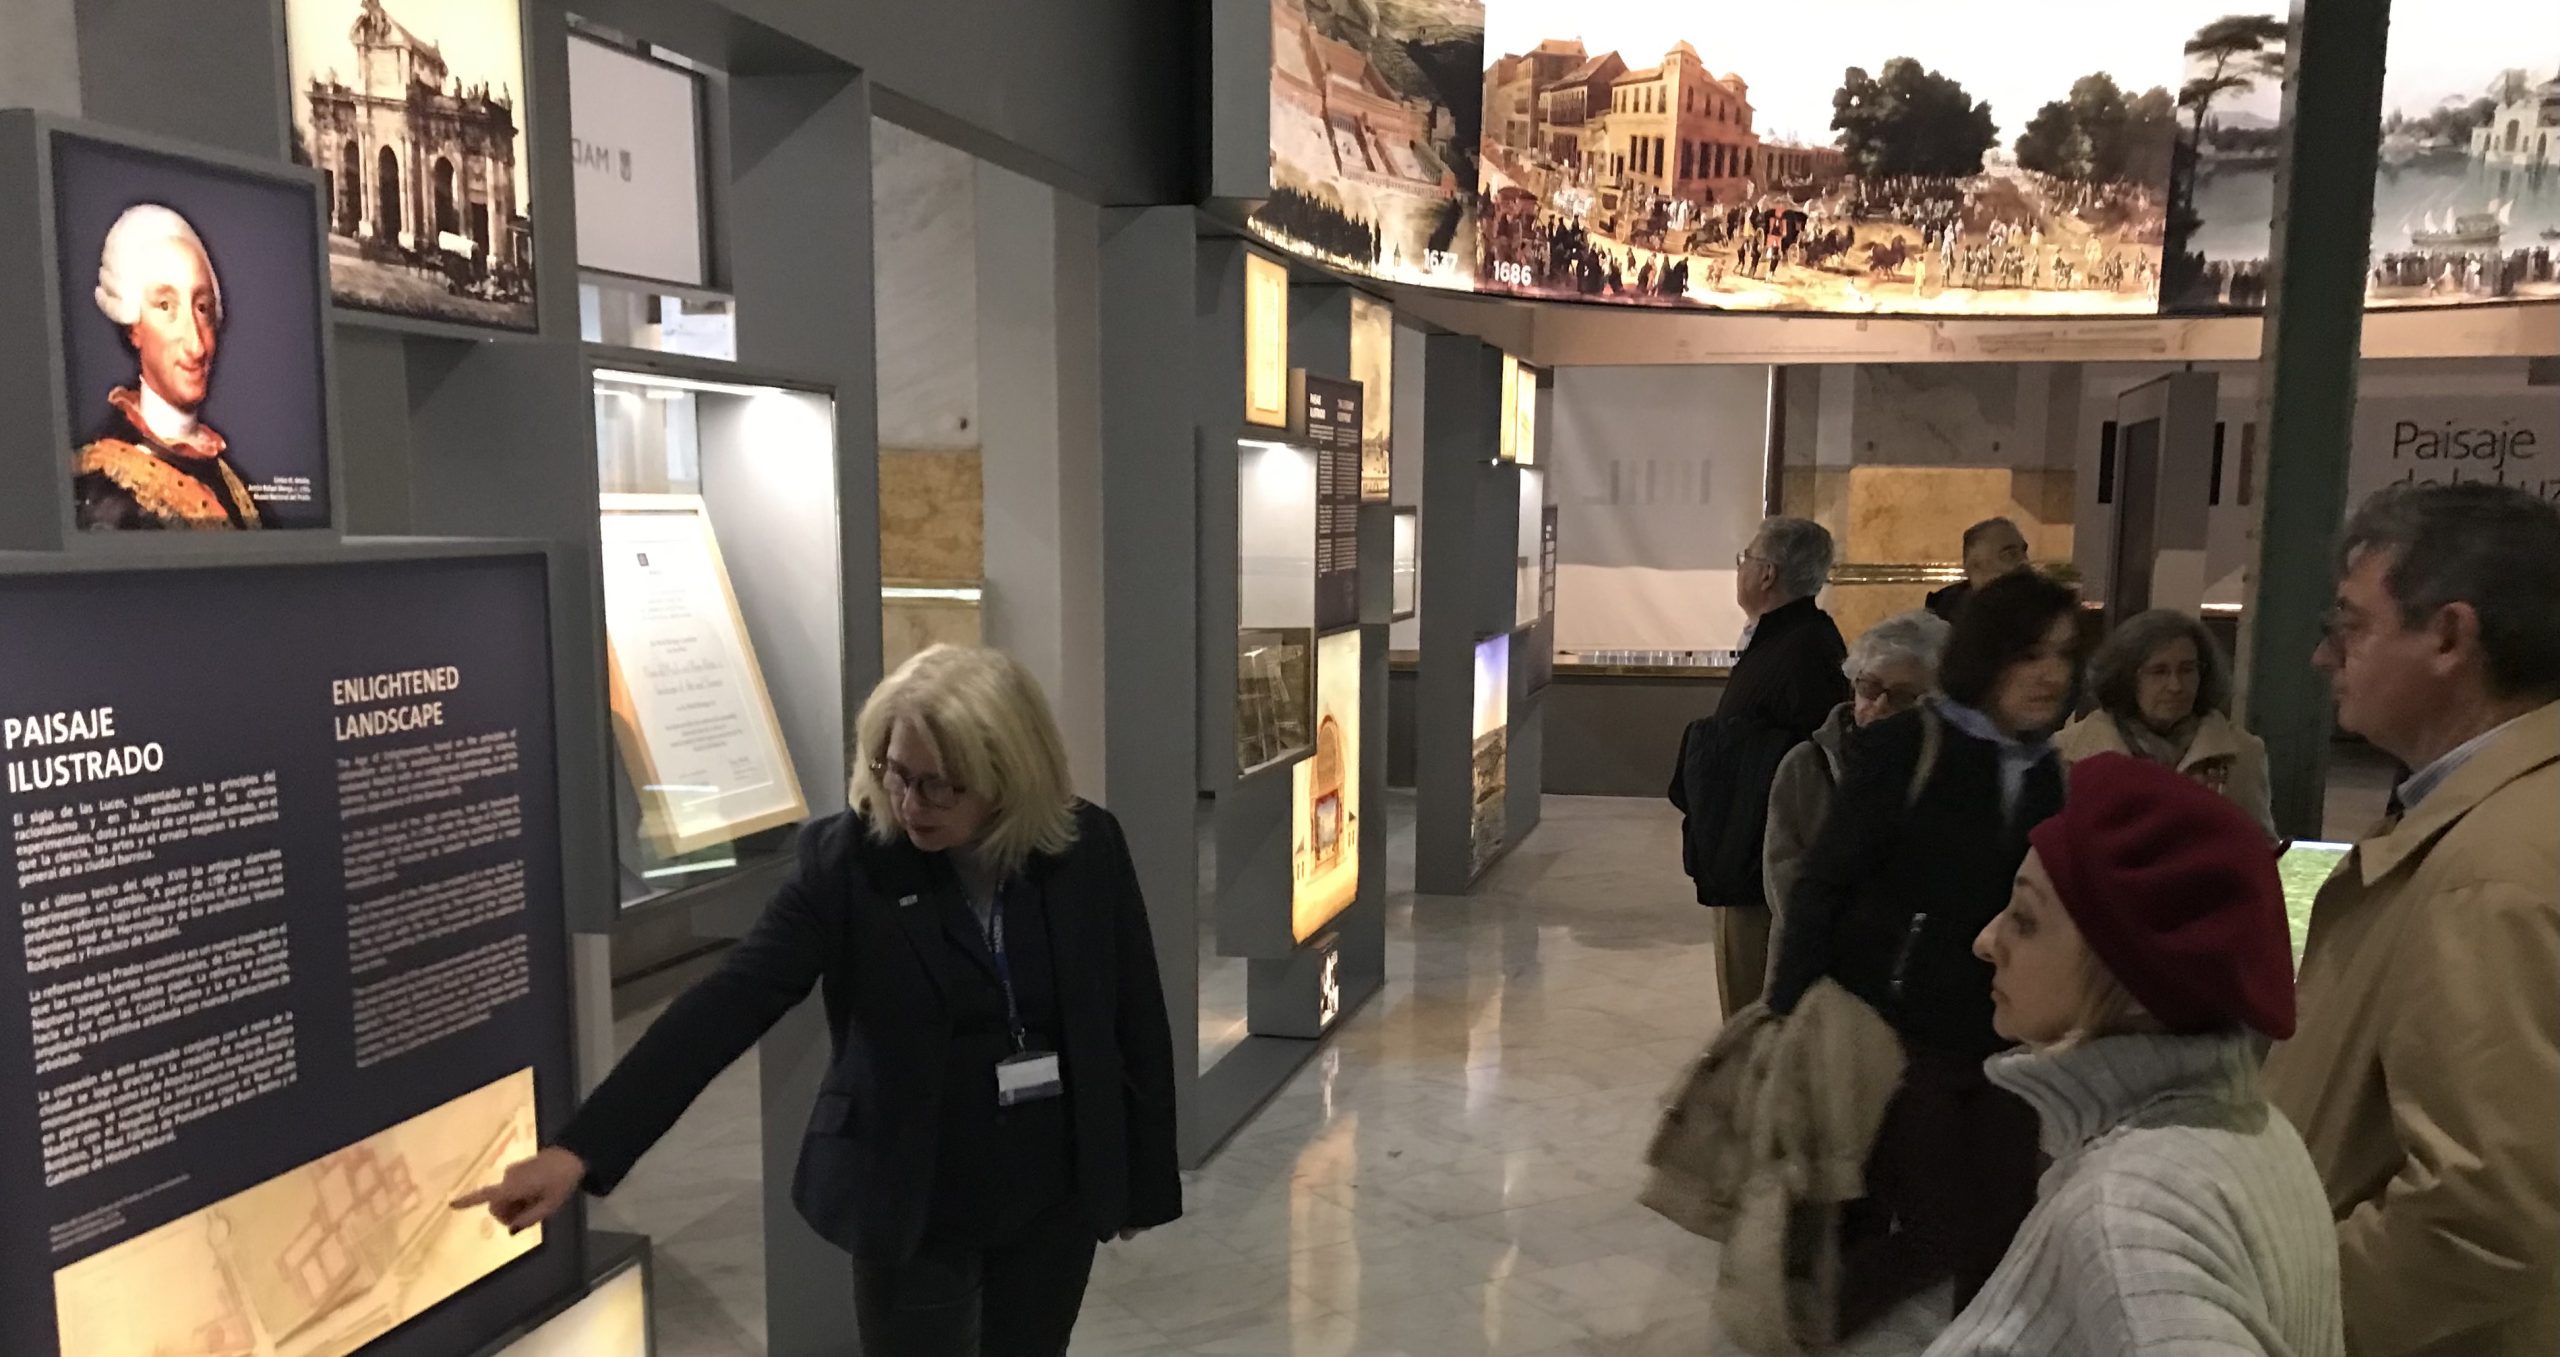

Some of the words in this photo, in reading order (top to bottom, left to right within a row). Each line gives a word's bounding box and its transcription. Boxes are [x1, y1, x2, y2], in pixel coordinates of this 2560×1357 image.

[1493, 260, 1532, 286] 1686
[2393, 421, 2538, 470] Paisaje
[333, 666, 459, 705] ENLIGHTENED
[4, 707, 115, 750] PAISAJE
[335, 702, 444, 741] LANDSCAPE
[8, 743, 163, 793] ILUSTRADO
[12, 813, 23, 825] El
[17, 858, 36, 872] que
[40, 854, 50, 865] la
